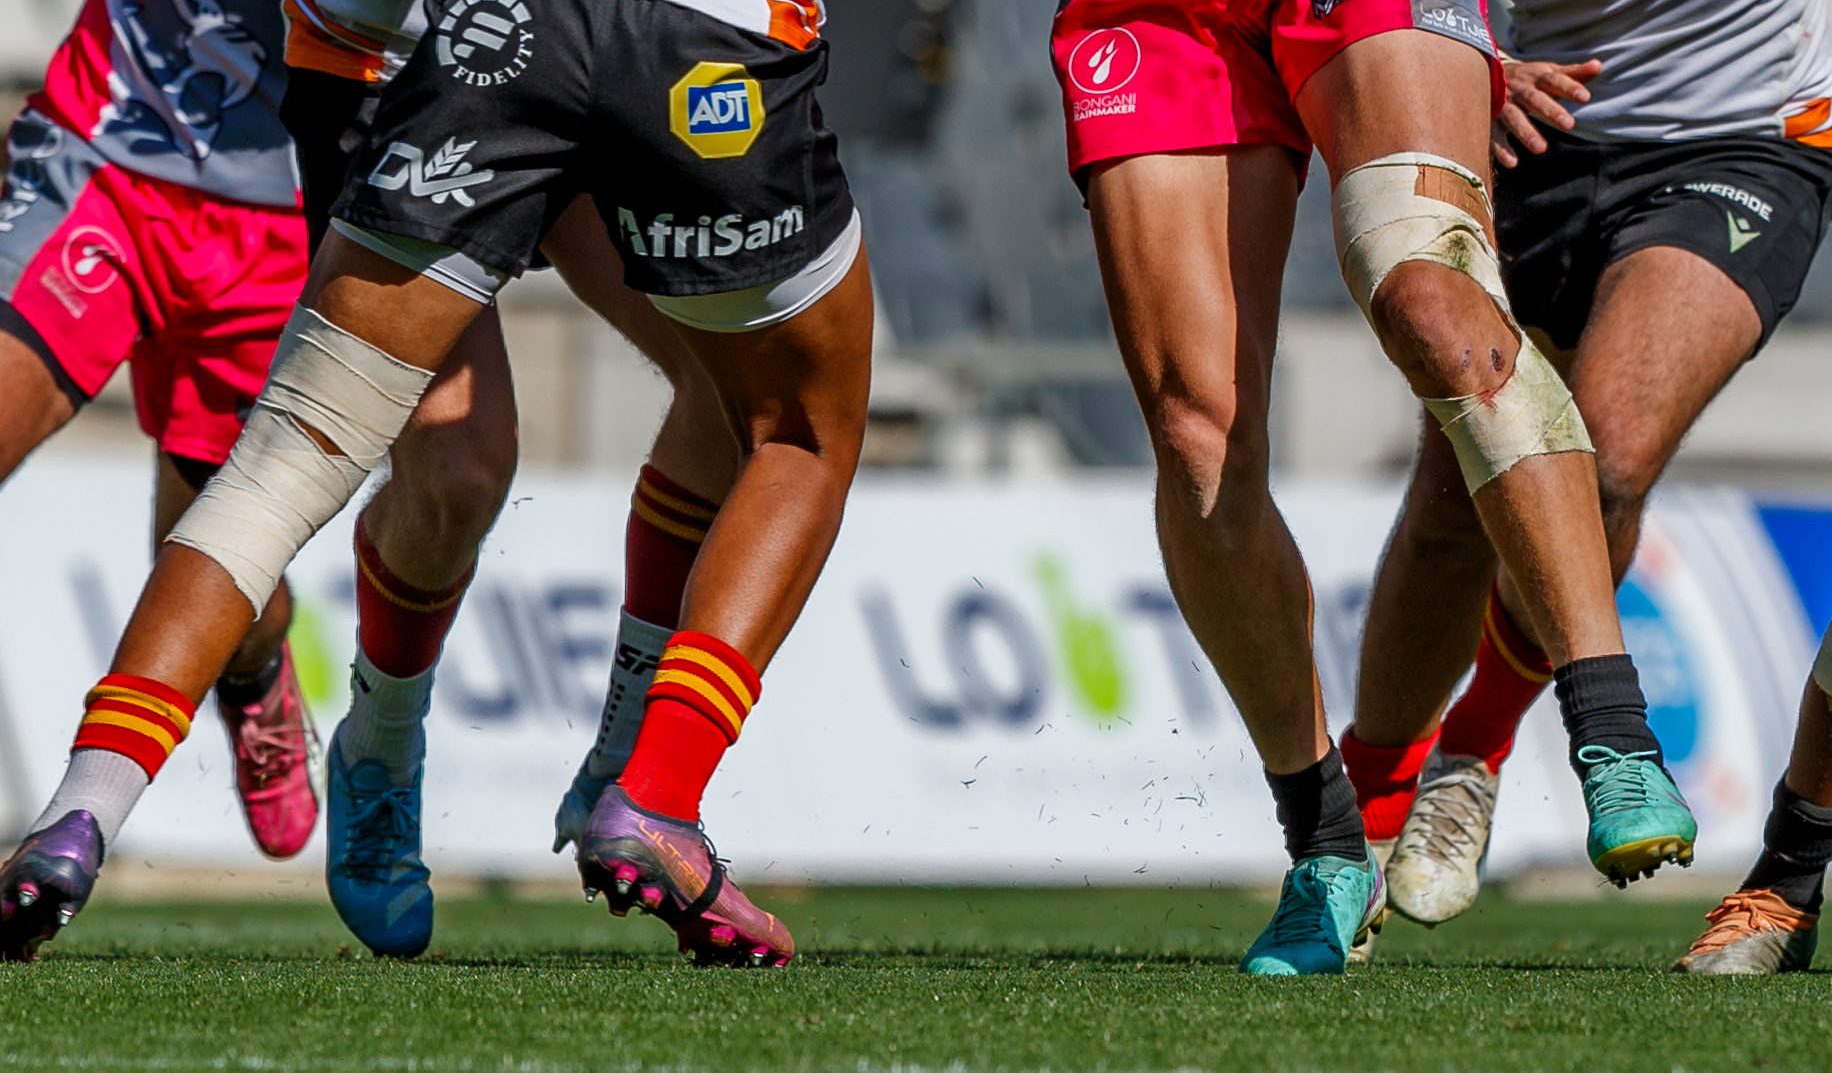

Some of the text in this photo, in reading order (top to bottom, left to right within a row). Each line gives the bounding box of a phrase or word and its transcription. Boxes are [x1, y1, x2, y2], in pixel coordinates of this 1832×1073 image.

[451, 28, 535, 87] FIDELITY
[688, 89, 748, 127] ADT
[1073, 92, 1137, 115] BONGANI
[1073, 103, 1137, 124] RAINMAKER
[617, 204, 804, 259] AfriSam
